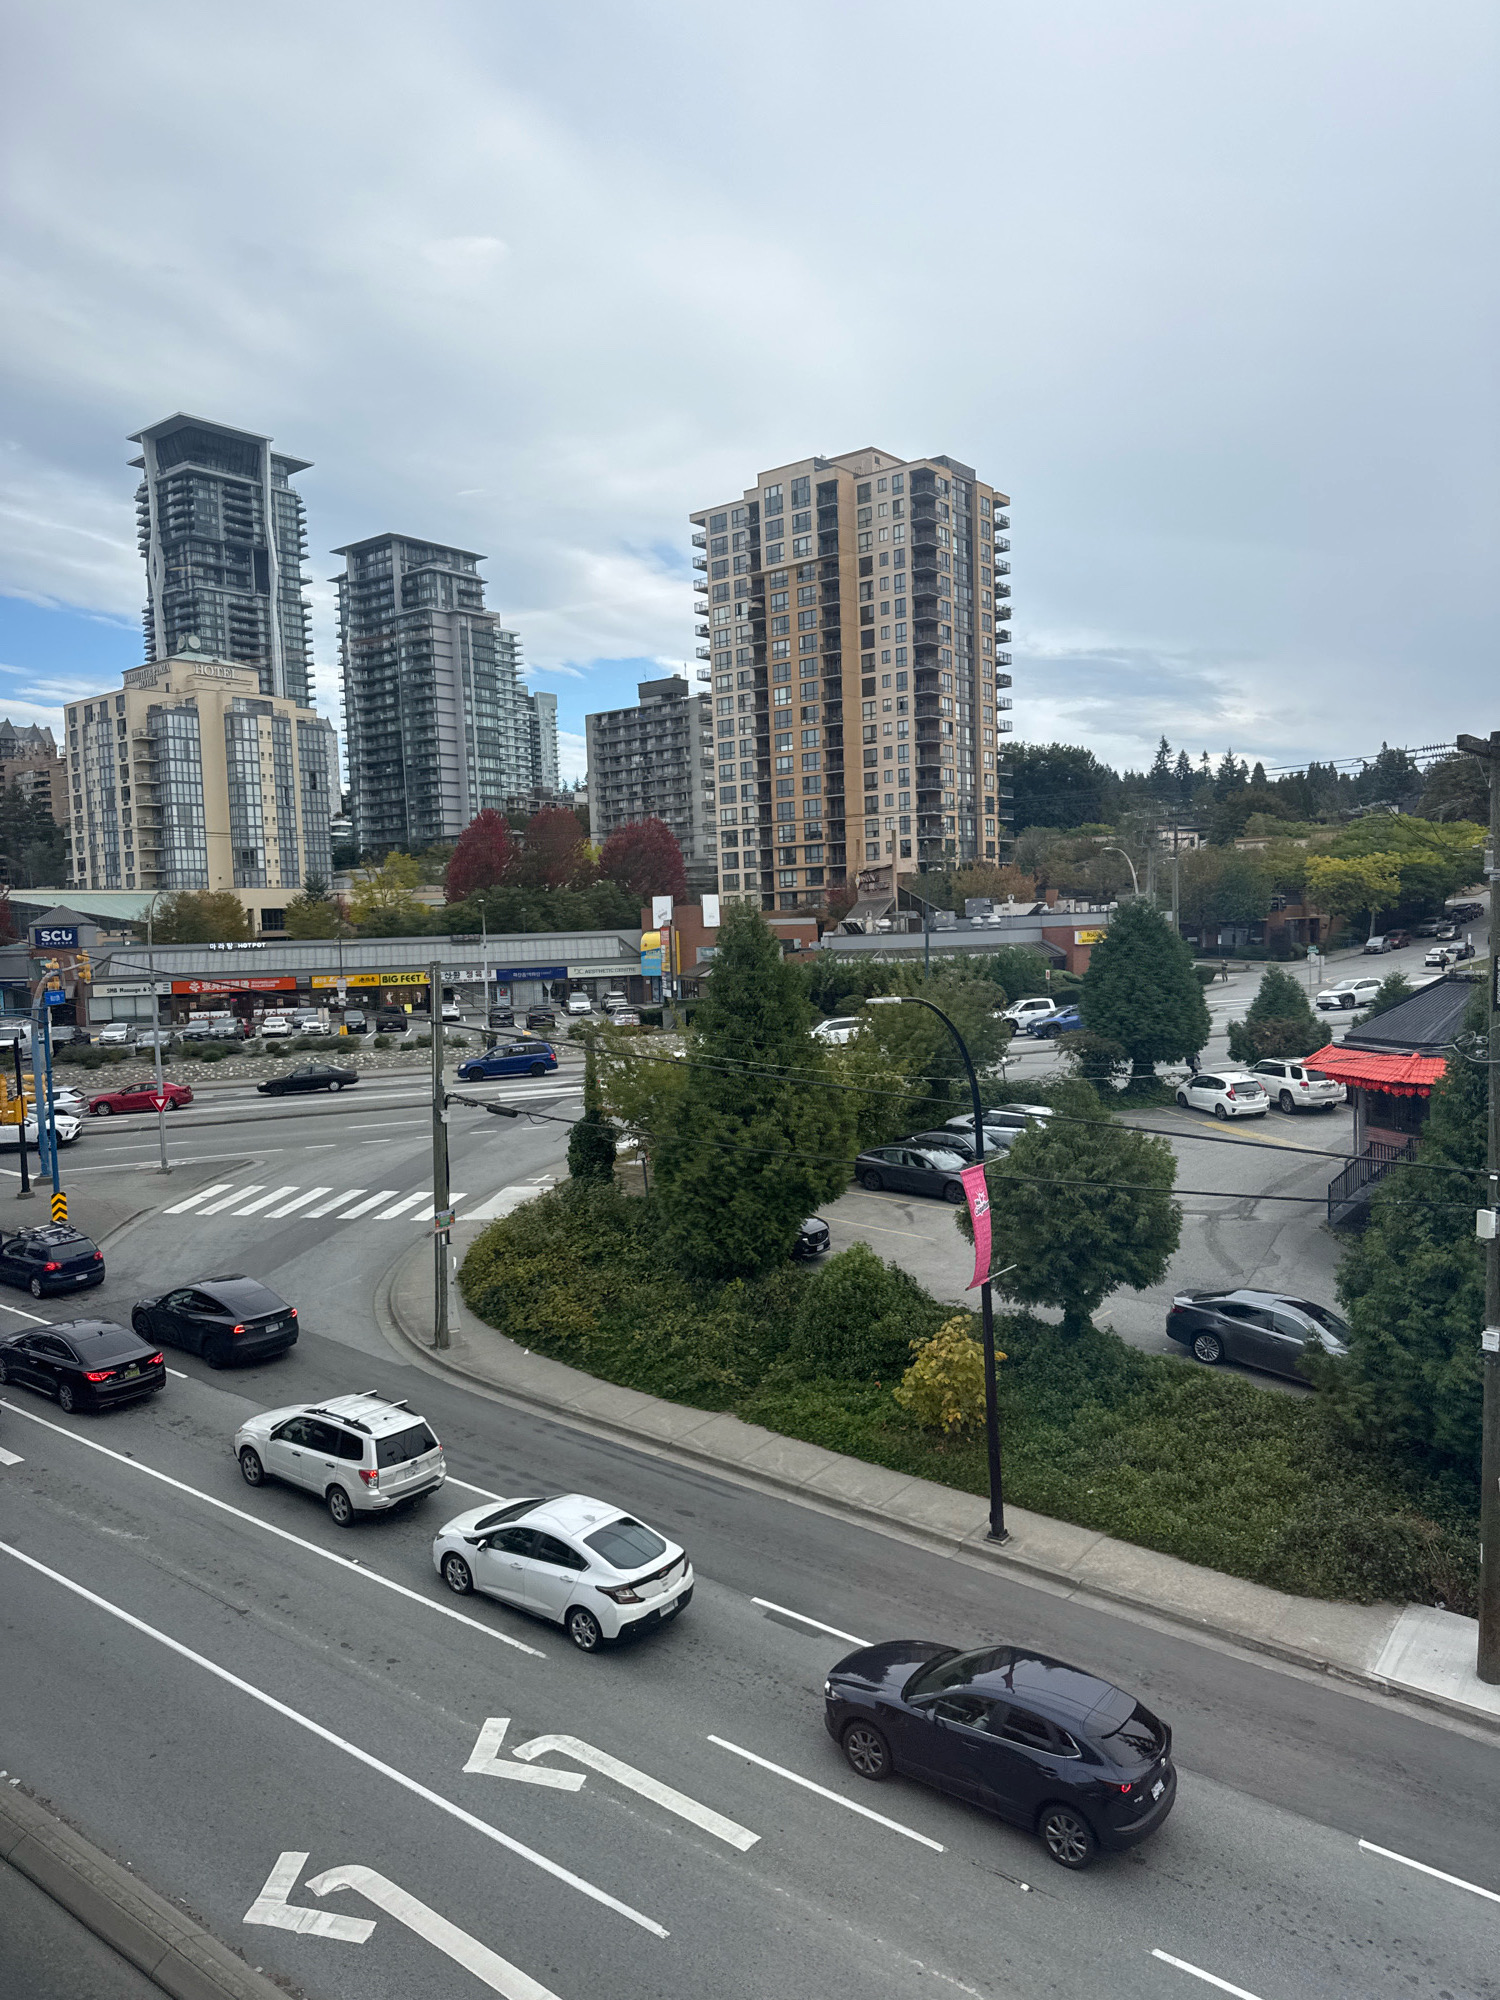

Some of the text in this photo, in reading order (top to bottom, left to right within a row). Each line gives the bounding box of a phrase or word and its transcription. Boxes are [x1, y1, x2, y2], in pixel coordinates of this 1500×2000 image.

[195, 664, 239, 679] HOTEL
[41, 930, 73, 942] SCU
[382, 975, 398, 984] BIG
[400, 974, 421, 983] FEET
